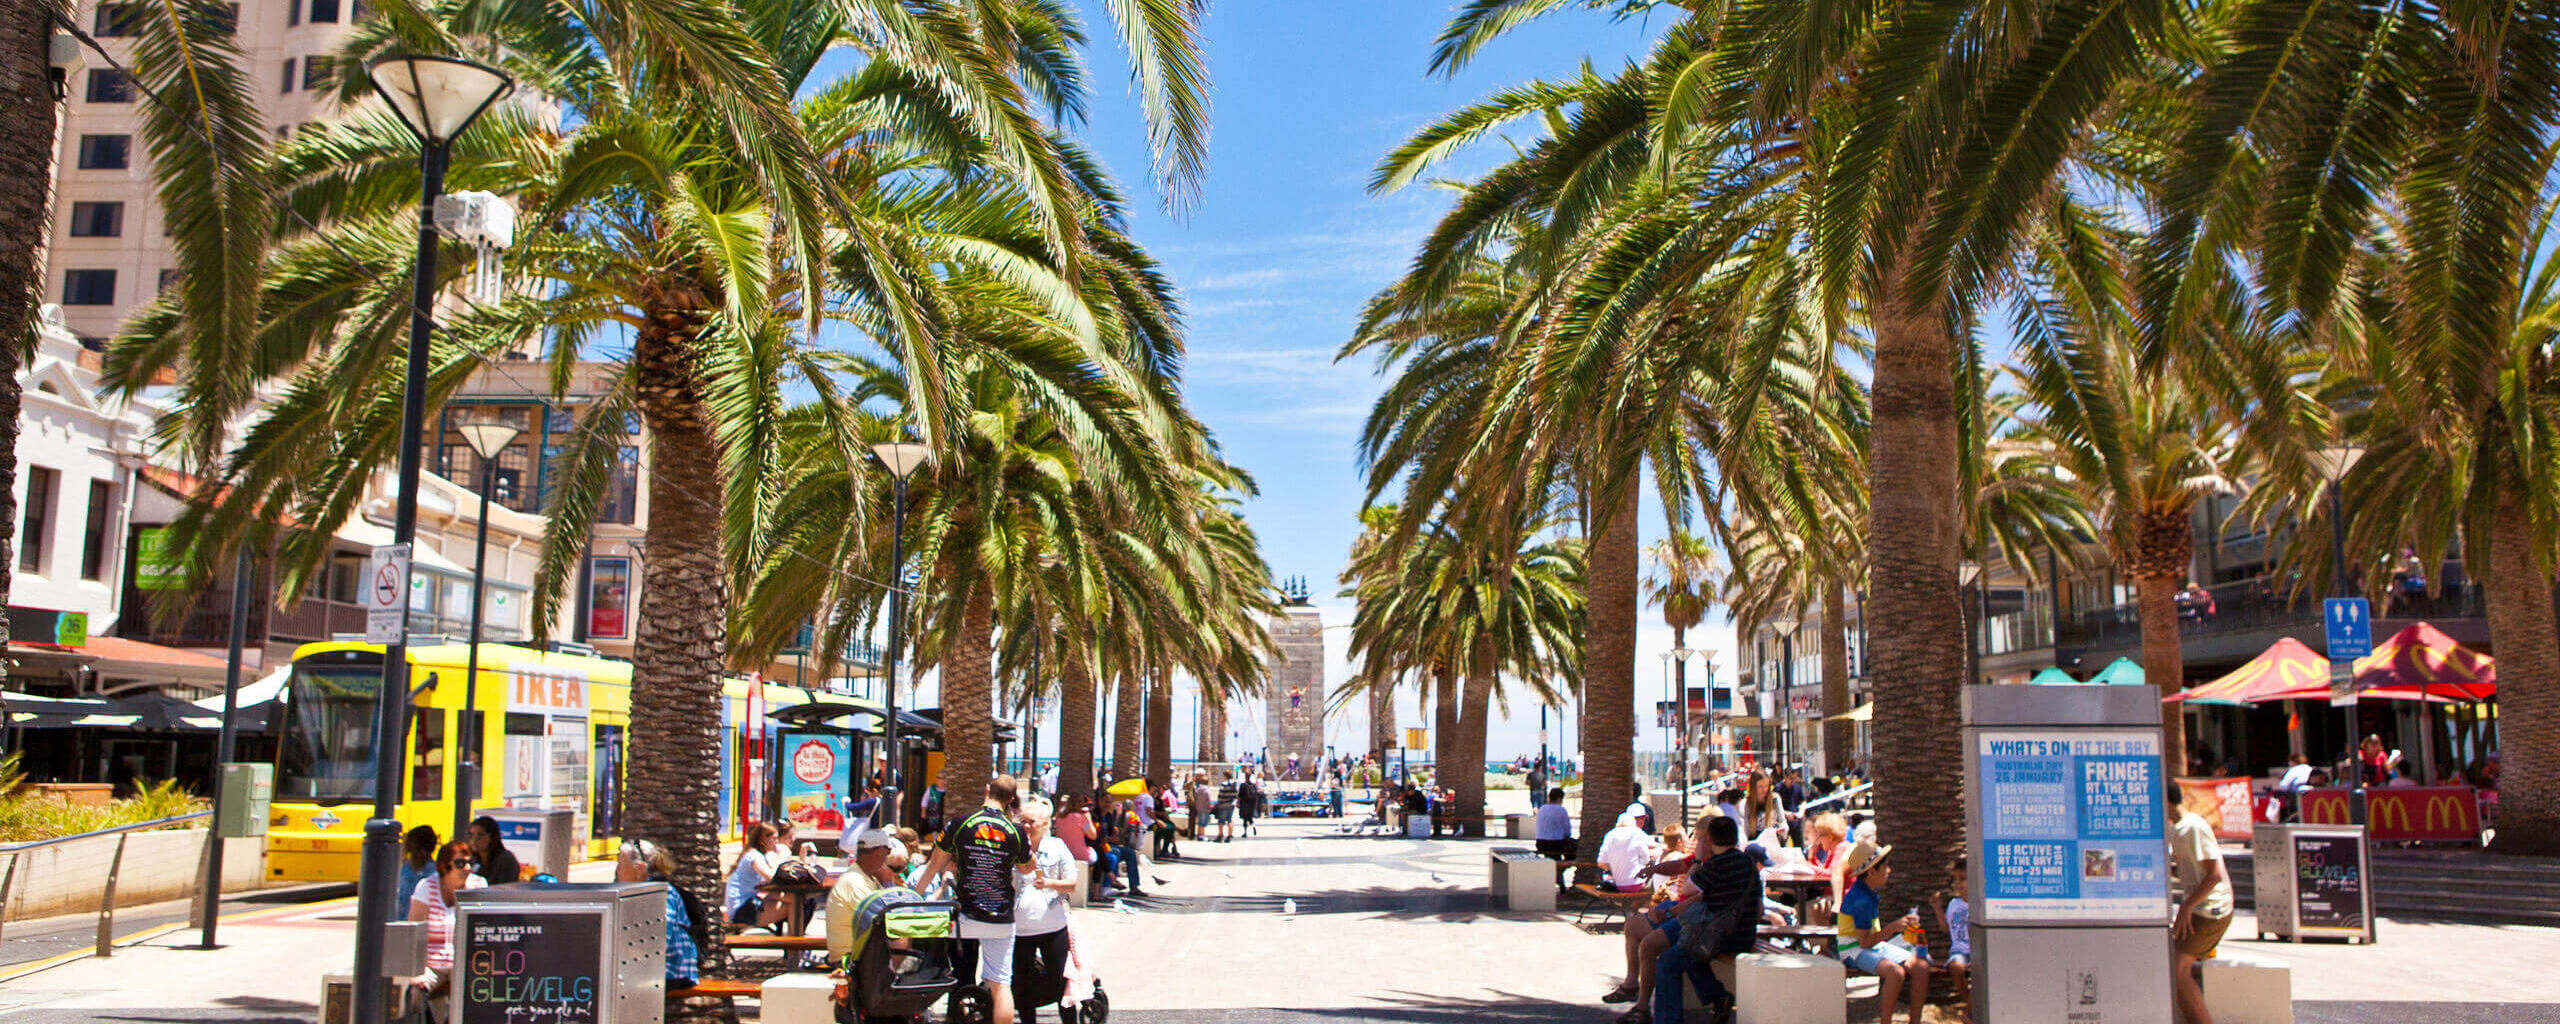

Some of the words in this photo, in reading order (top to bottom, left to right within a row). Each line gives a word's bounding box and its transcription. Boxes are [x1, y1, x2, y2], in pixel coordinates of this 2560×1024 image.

[516, 670, 583, 708] IKEA
[1990, 740, 2047, 756] WHAT'S
[2051, 740, 2070, 756] ON
[2074, 740, 2092, 756] AT
[2096, 740, 2121, 756] THE
[2125, 740, 2151, 756] BAY
[1995, 761, 2043, 770] AUSTRALIA
[2085, 761, 2149, 781] FRINGE
[1995, 771, 2009, 783] 26
[2013, 771, 2064, 783] JANUARY
[2086, 782, 2100, 794] AT
[2104, 782, 2124, 794] THE
[2127, 782, 2149, 794] BAY
[2025, 804, 2066, 815] MUSTER
[2094, 818, 2140, 830] GLENELG
[1998, 844, 2012, 856] BE
[2014, 844, 2053, 856] ACTIVE
[1998, 855, 2012, 866] AT
[2013, 855, 2031, 866] THE
[2034, 855, 2051, 866] BAY
[474, 926, 496, 934] NEW
[497, 926, 525, 934] YEAR'S
[527, 926, 542, 934] EVE
[474, 934, 486, 942] AT
[487, 934, 502, 942] THE
[504, 934, 520, 942] BAY
[472, 950, 525, 976] GLO
[471, 976, 593, 1003] GLENELG
